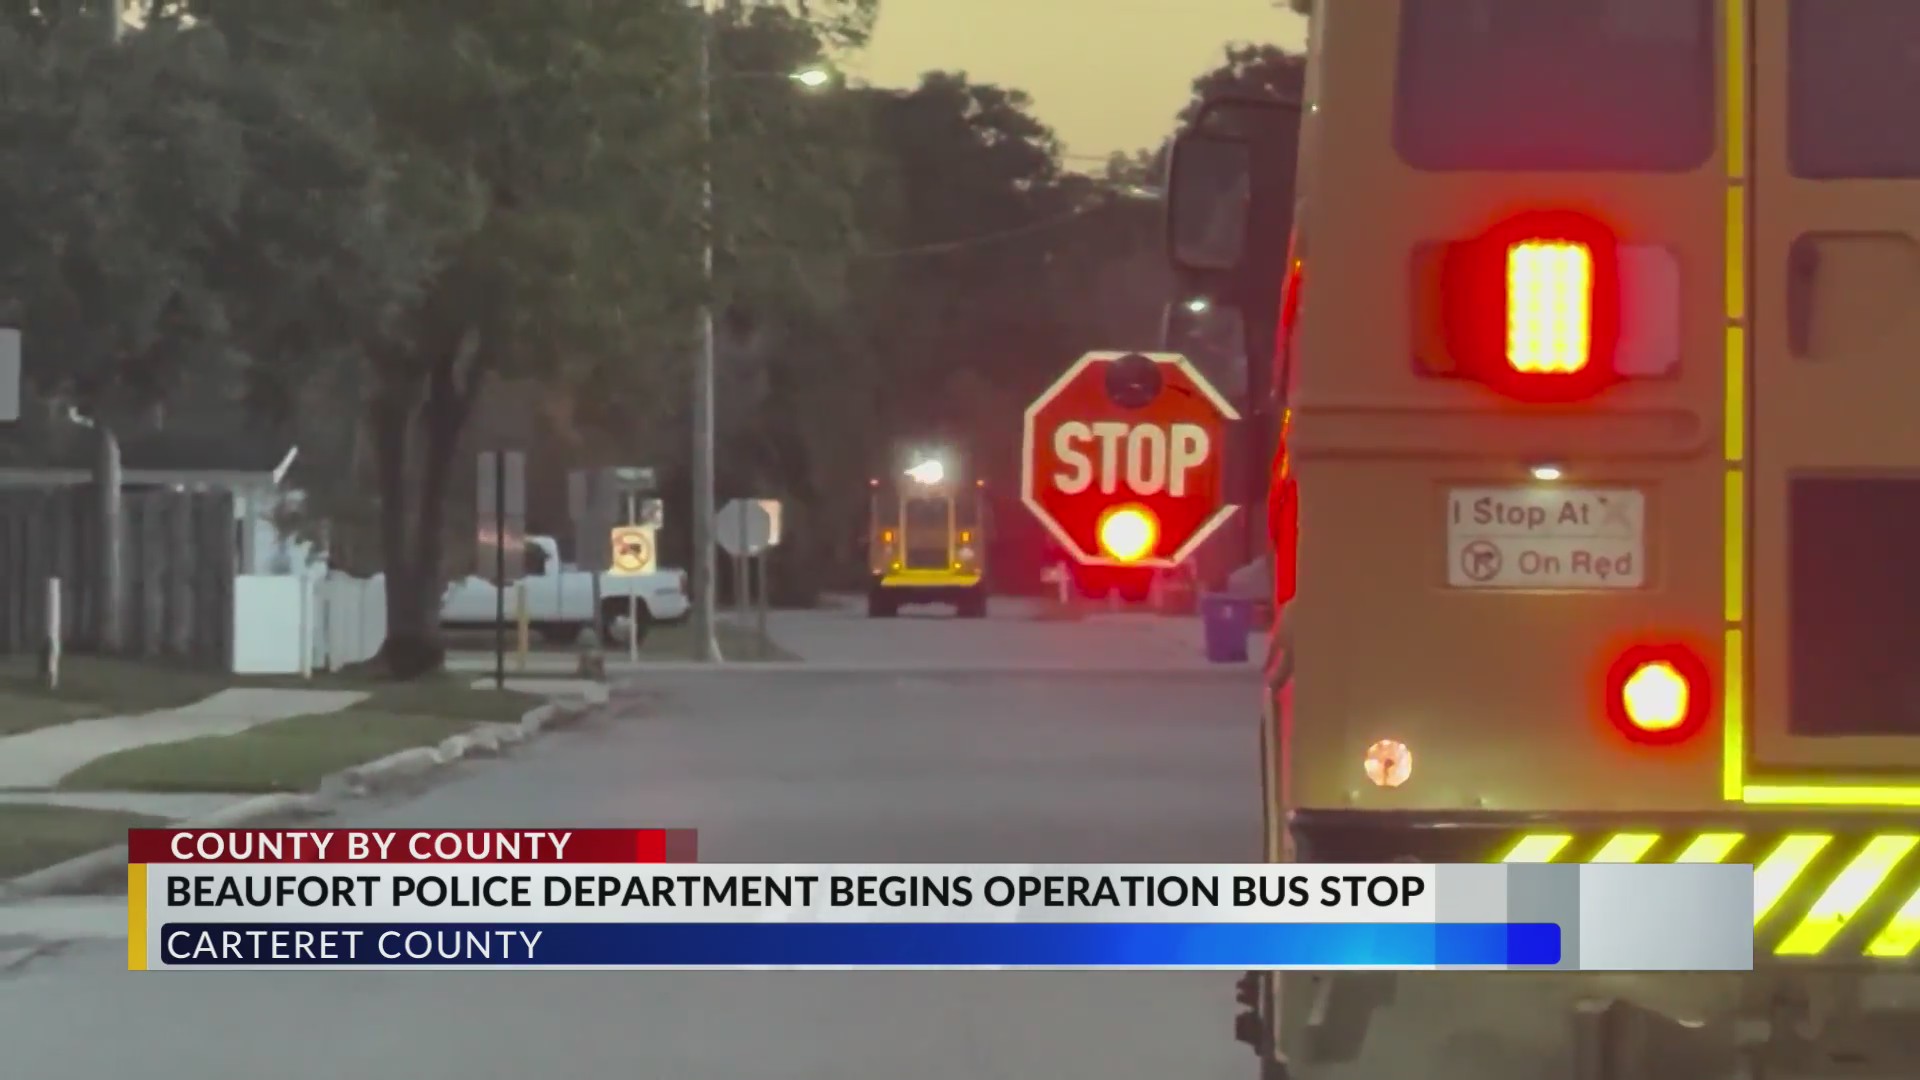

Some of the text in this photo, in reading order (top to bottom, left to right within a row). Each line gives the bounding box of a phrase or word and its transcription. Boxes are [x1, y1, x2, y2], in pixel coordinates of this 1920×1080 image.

[1053, 421, 1210, 497] STOP
[1453, 500, 1590, 529] I Stop At
[1518, 550, 1633, 575] On Red
